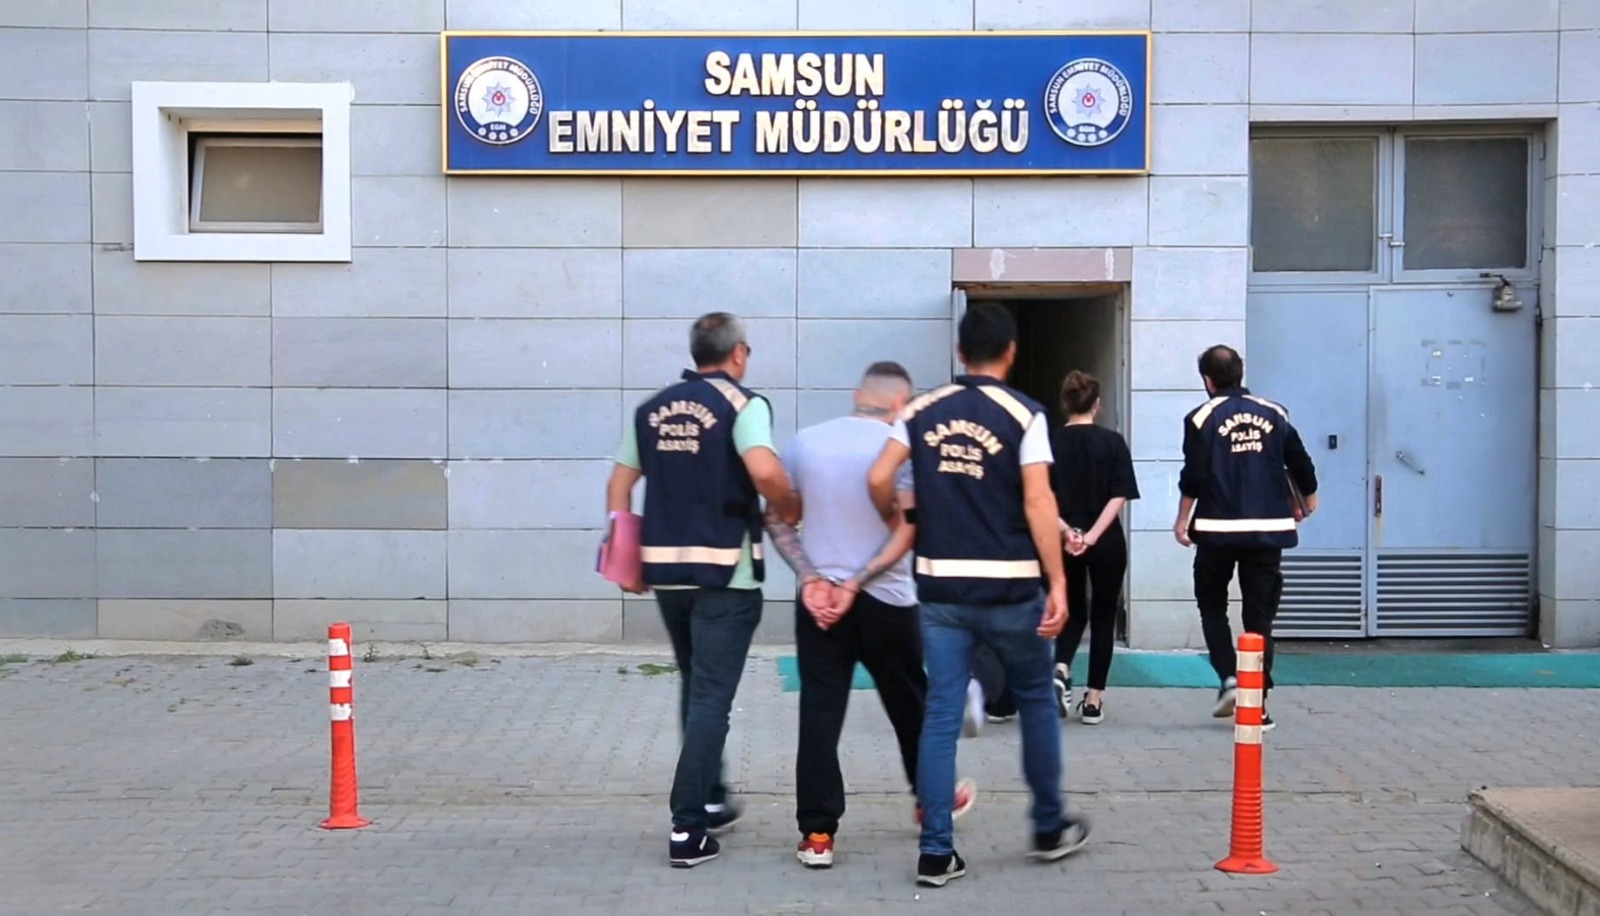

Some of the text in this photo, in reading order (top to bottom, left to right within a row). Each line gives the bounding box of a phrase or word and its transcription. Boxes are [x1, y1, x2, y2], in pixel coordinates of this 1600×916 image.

[705, 51, 884, 96] SAMSUN
[1048, 76, 1065, 114] SAMSUN
[548, 98, 1029, 153] EMNİYET MÜDÜRLÜĞÜ
[648, 400, 718, 429] SAMSUN
[659, 421, 700, 437] POLİS
[1218, 412, 1274, 437] SAMSUN
[923, 419, 1003, 455] SAMSUN
[940, 443, 983, 462] POLİS
